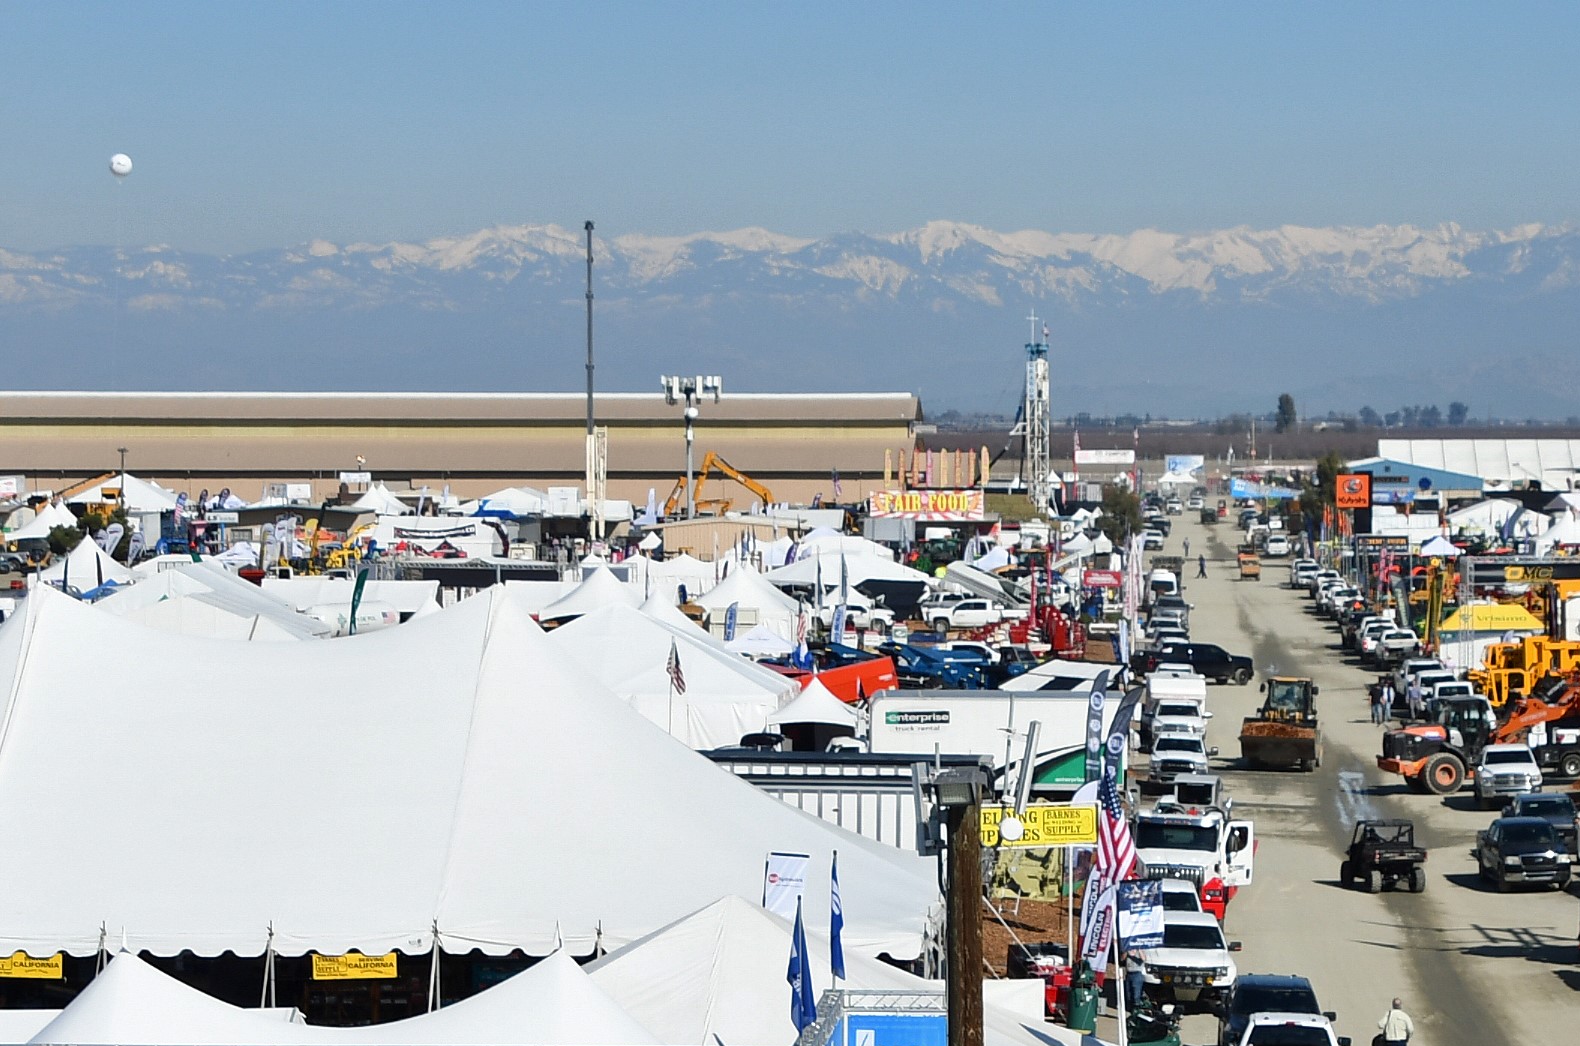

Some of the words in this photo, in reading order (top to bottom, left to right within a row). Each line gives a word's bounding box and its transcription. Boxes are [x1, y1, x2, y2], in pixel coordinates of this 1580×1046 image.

[884, 493, 921, 512] FAIR
[927, 493, 968, 512] FOOD
[887, 712, 949, 723] enterprise
[1046, 810, 1081, 820] BARNES
[1046, 825, 1081, 834] SUPPLY
[13, 961, 60, 969] CALIFORNIA
[347, 961, 395, 969] CALIFORNIA
